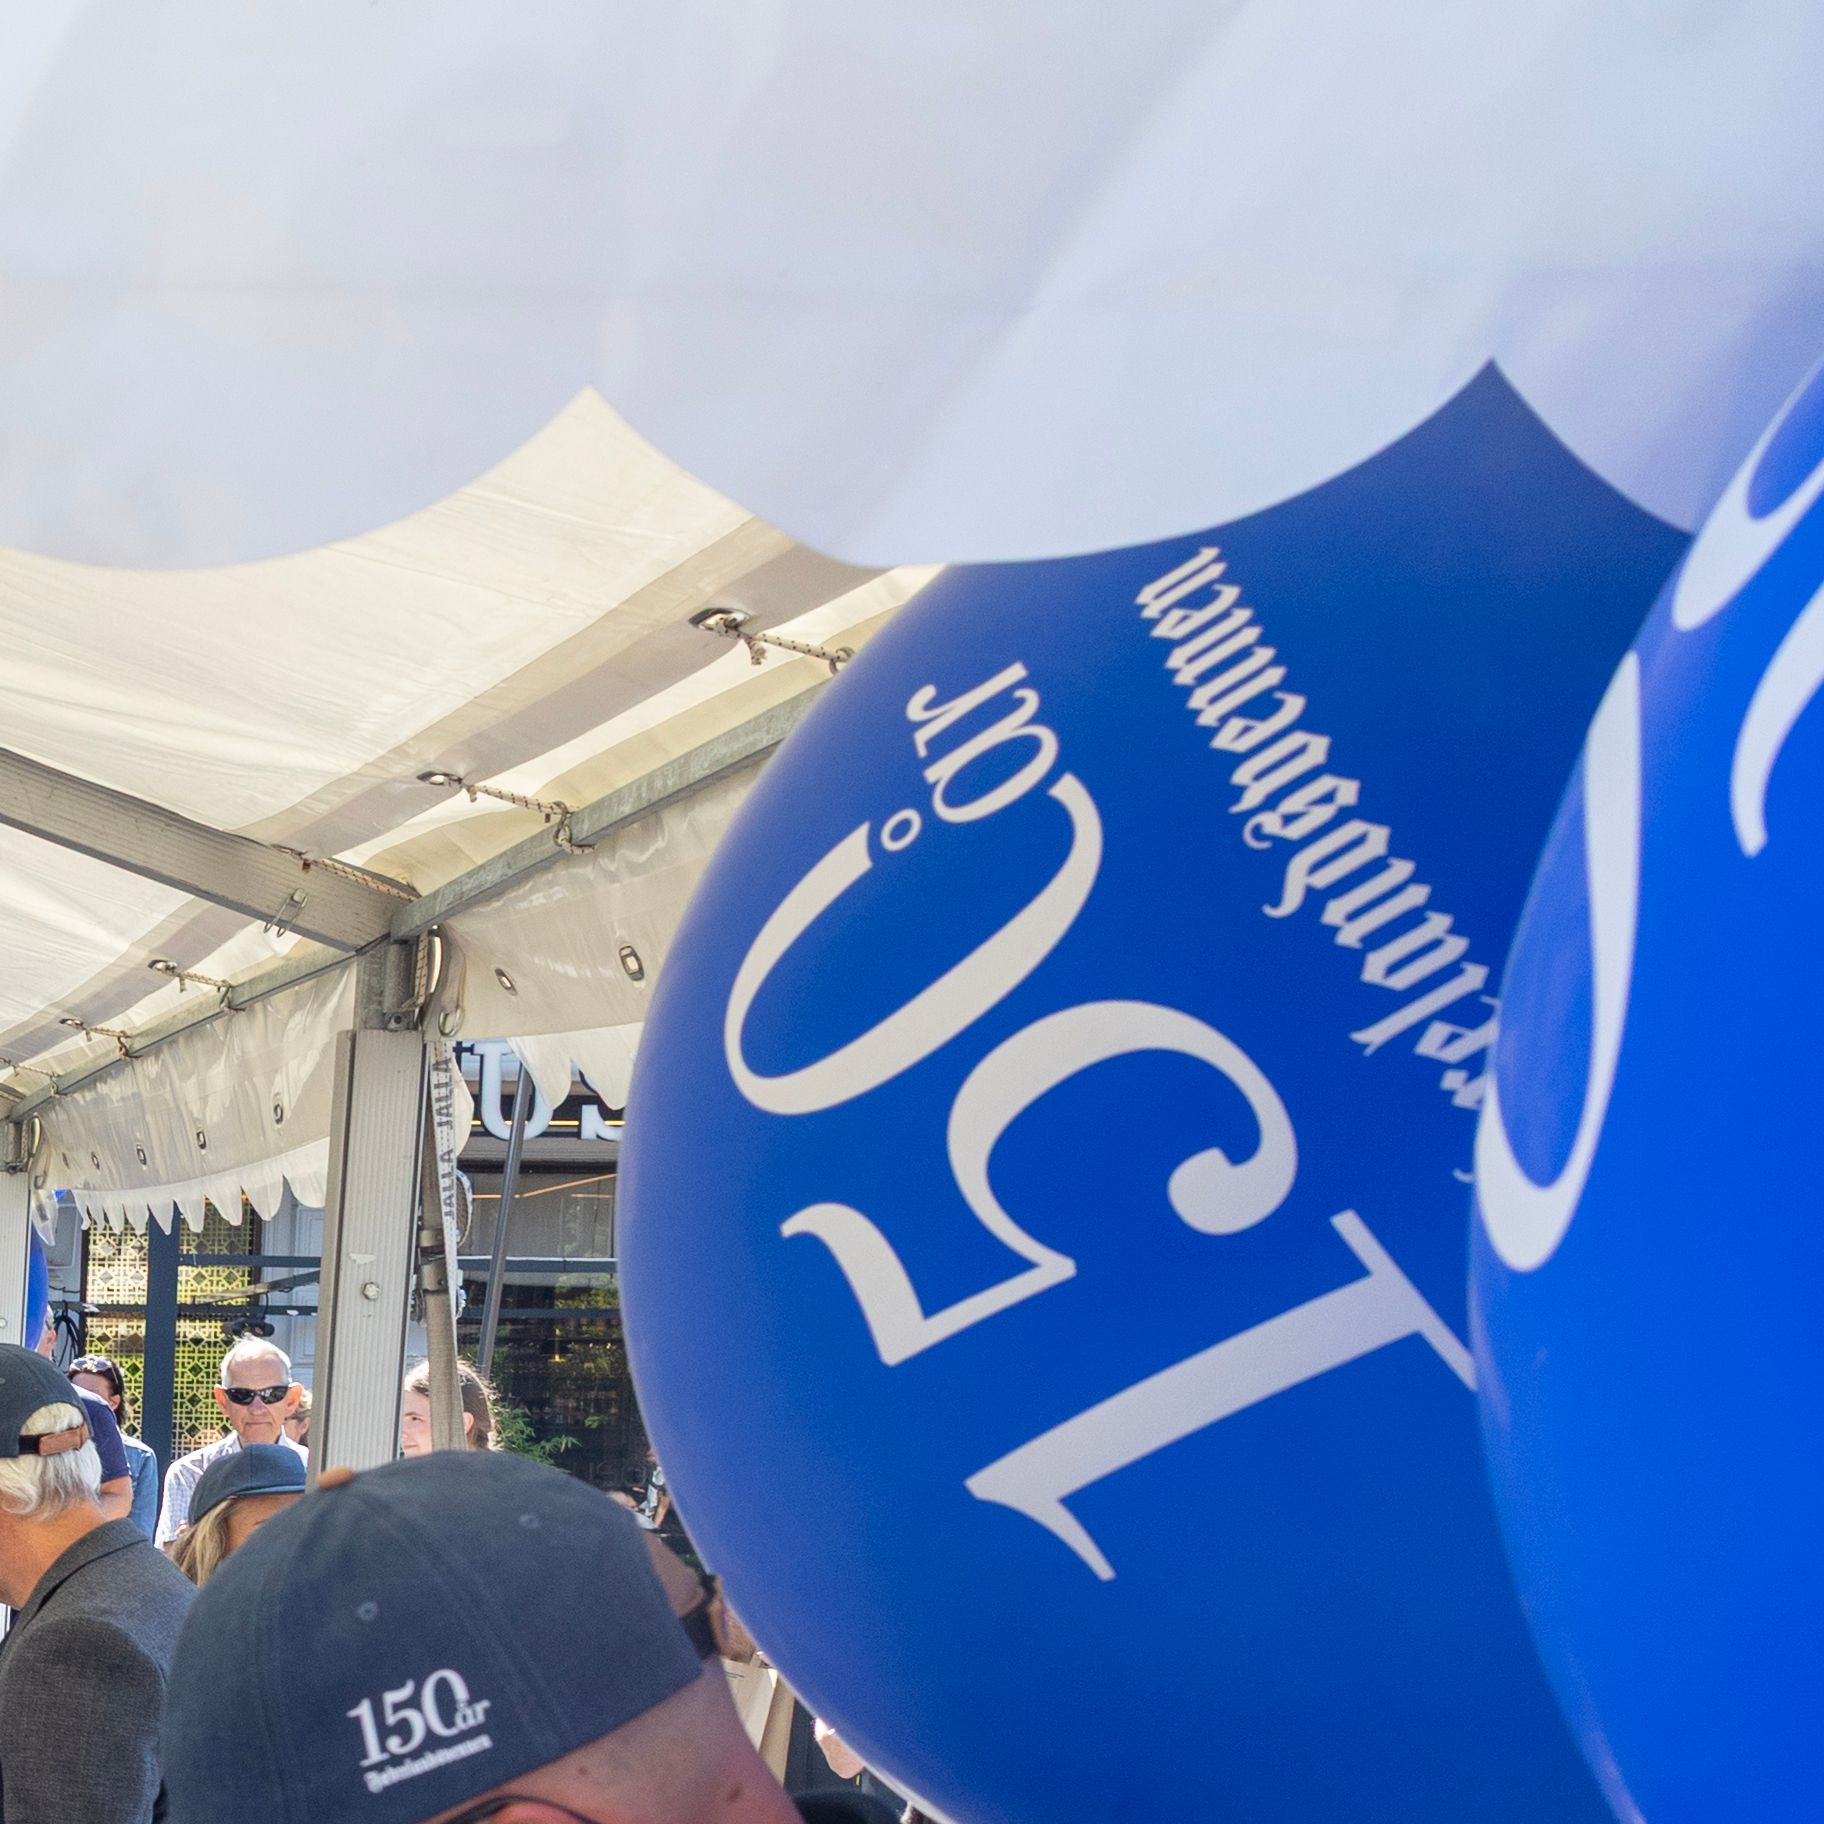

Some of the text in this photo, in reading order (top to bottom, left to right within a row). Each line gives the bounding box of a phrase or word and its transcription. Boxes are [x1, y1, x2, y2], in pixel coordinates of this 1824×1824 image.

[432, 1057, 455, 1221] JALLA JALLA
[723, 773, 1479, 1581] 150
[346, 1668, 470, 1768] 150
